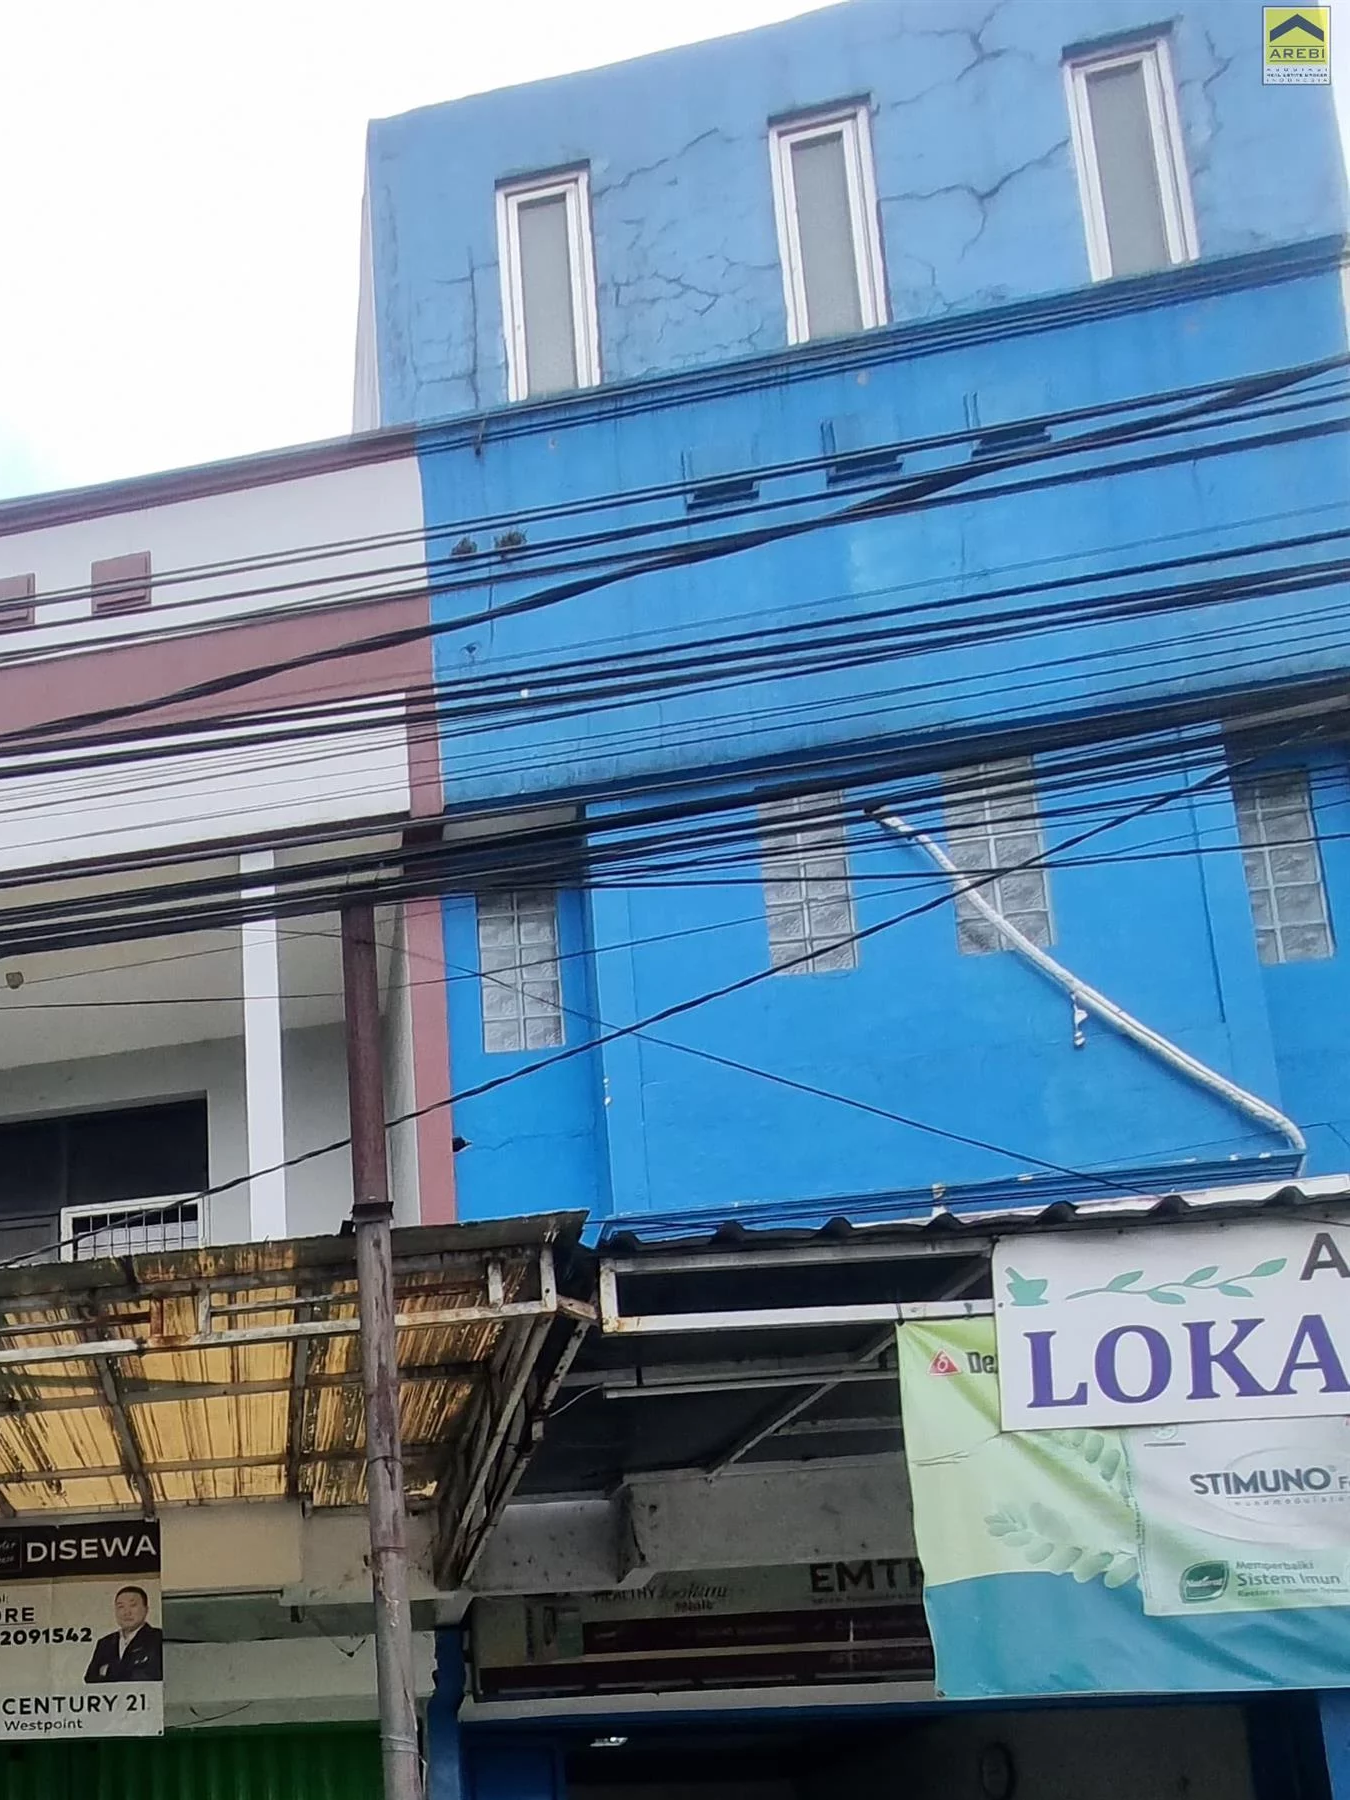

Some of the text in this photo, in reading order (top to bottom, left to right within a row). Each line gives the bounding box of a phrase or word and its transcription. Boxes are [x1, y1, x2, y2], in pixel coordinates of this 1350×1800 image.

[965, 1351, 998, 1374] De
[1023, 1314, 1350, 1408] LOKA
[1190, 1467, 1332, 1495] STIMUNO
[26, 1535, 157, 1563] DISEWA
[1237, 1573, 1296, 1587] Sistem
[1299, 1573, 1341, 1585] Imun
[2, 1694, 146, 1715] CENTURY 21
[4, 1718, 83, 1731] Westpoint
